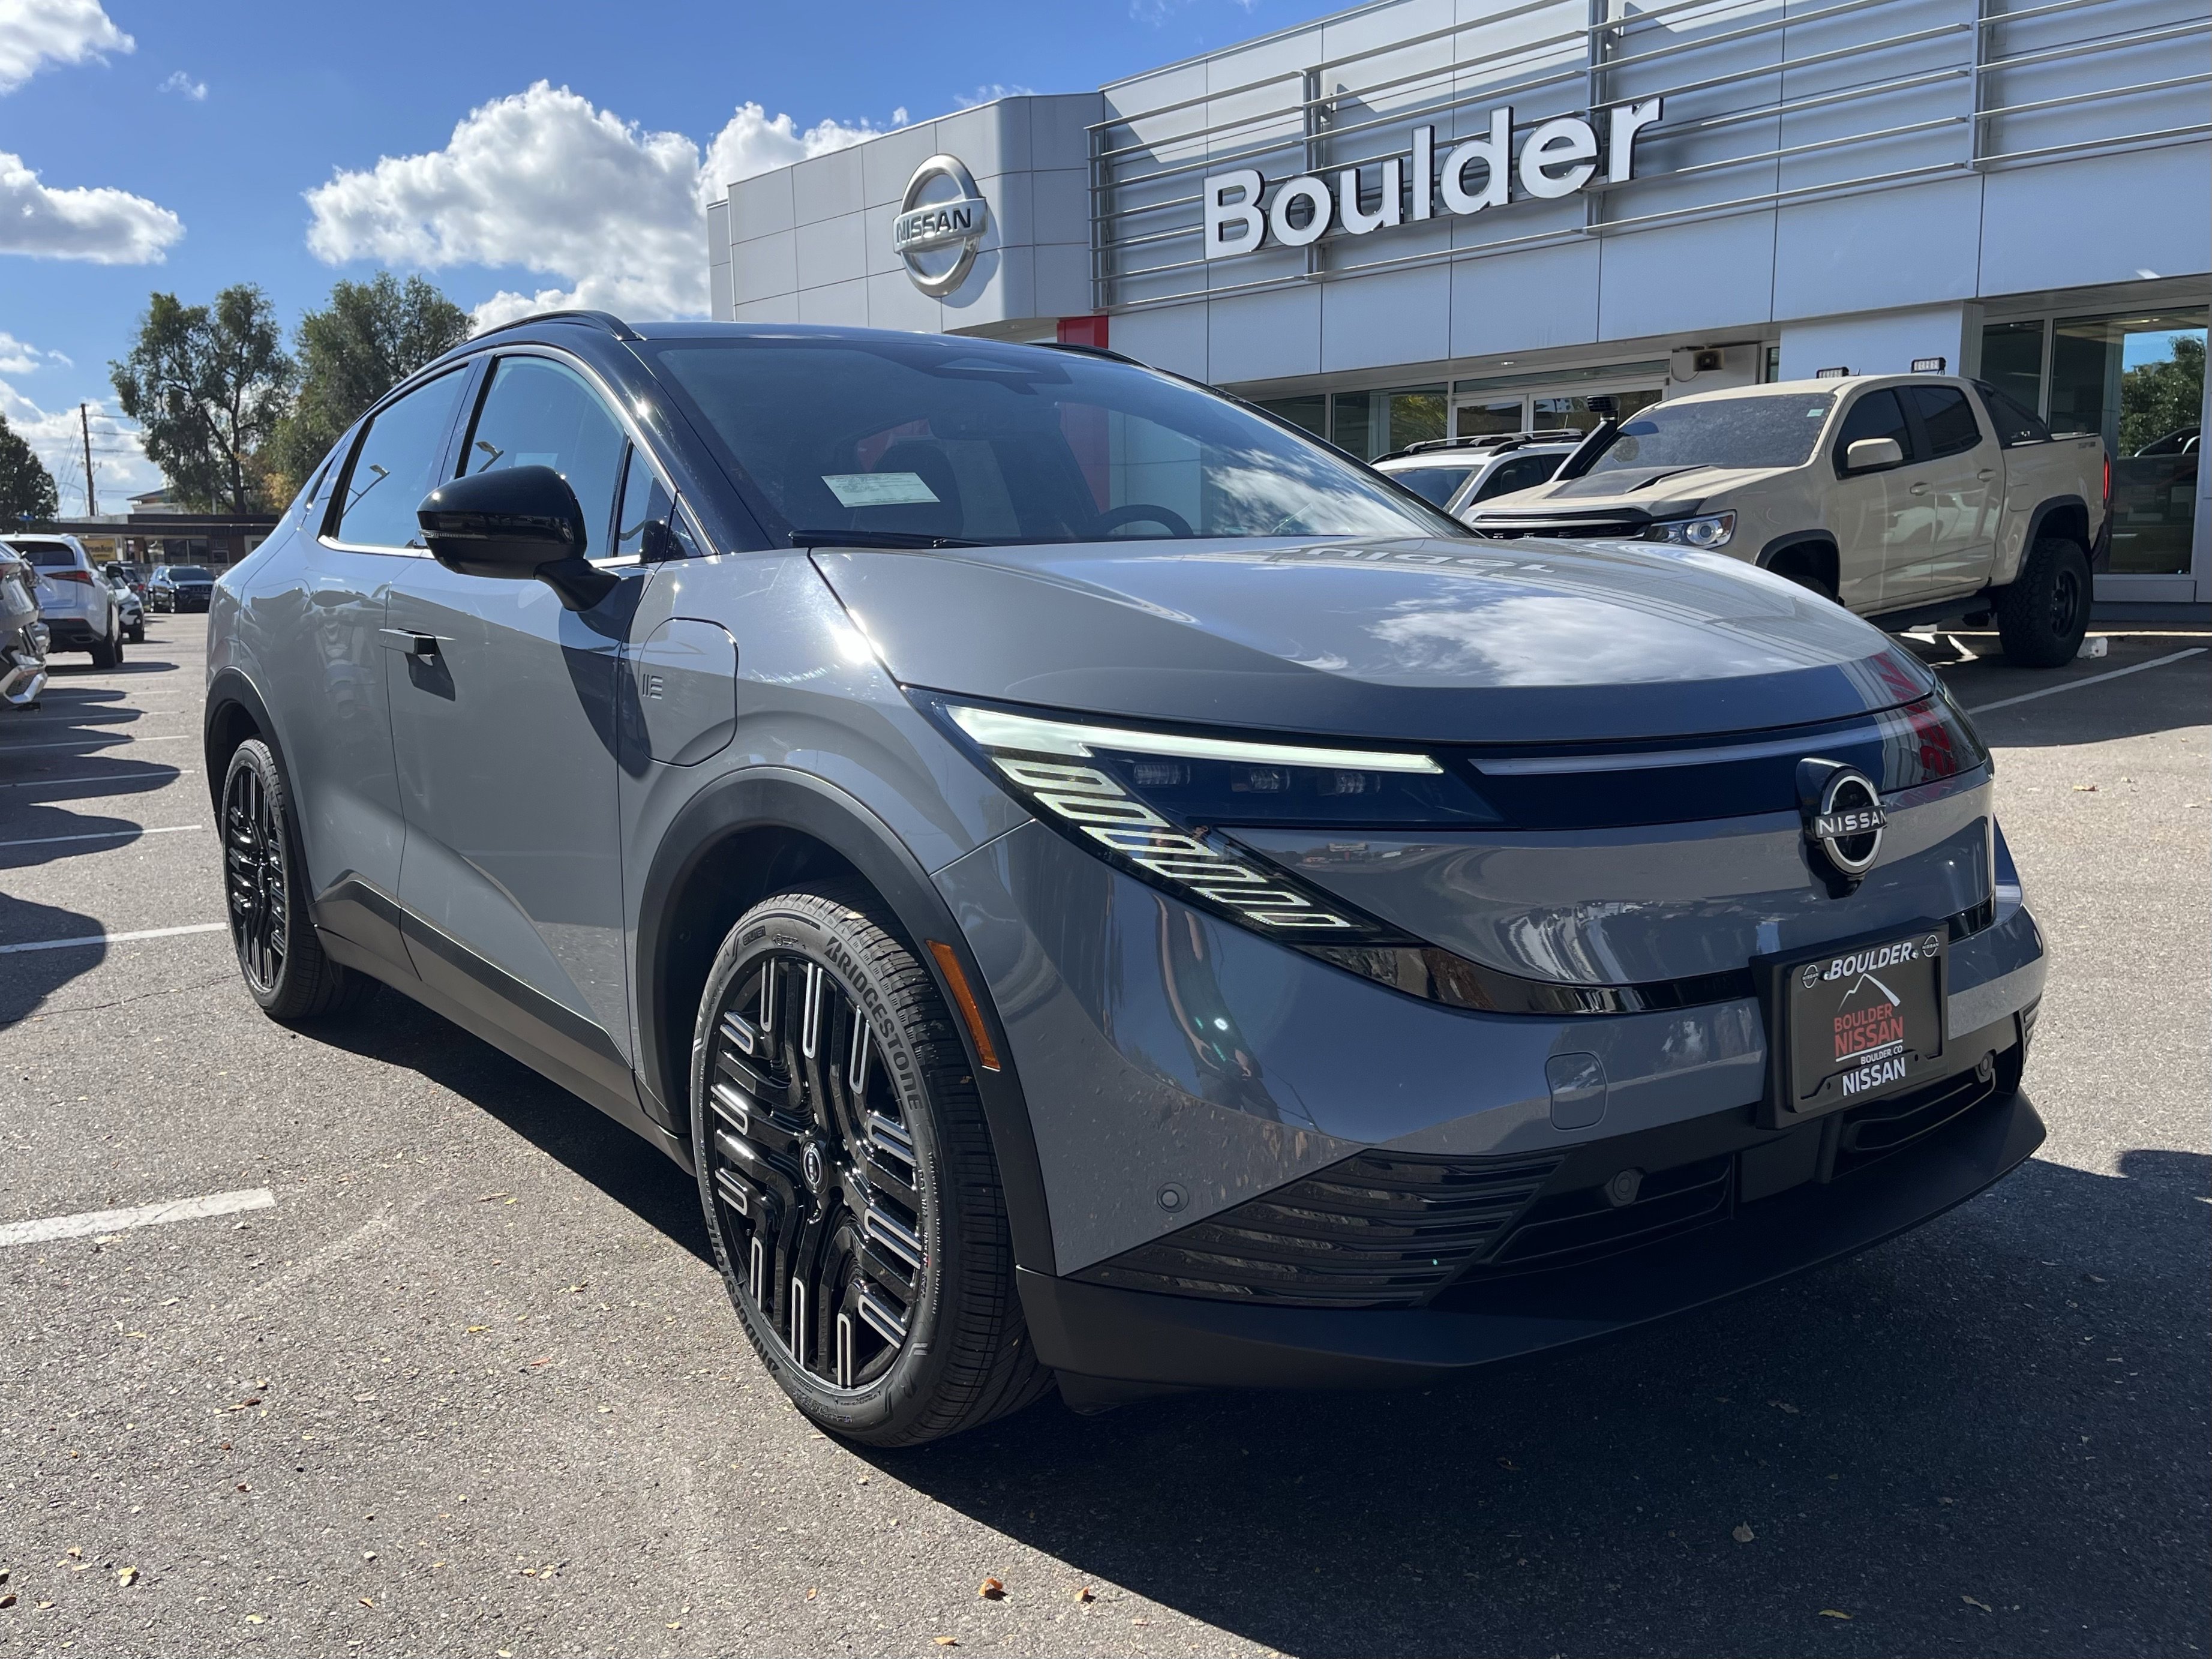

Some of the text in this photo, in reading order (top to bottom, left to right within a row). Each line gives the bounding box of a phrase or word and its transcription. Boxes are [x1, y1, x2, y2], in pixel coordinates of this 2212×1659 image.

[1203, 97, 1664, 260] Boulder
[896, 206, 971, 243] NISSAN
[1818, 809, 1886, 834] NISSAN
[1829, 941, 1912, 981] BOULDER
[824, 936, 925, 1111] BRIDGESTONE
[1834, 1003, 1893, 1033] BOULDER
[1835, 1016, 1904, 1057] NISSAN
[1860, 1045, 1903, 1065] BOULDER, CO
[1842, 1057, 1906, 1097] NISSAN
